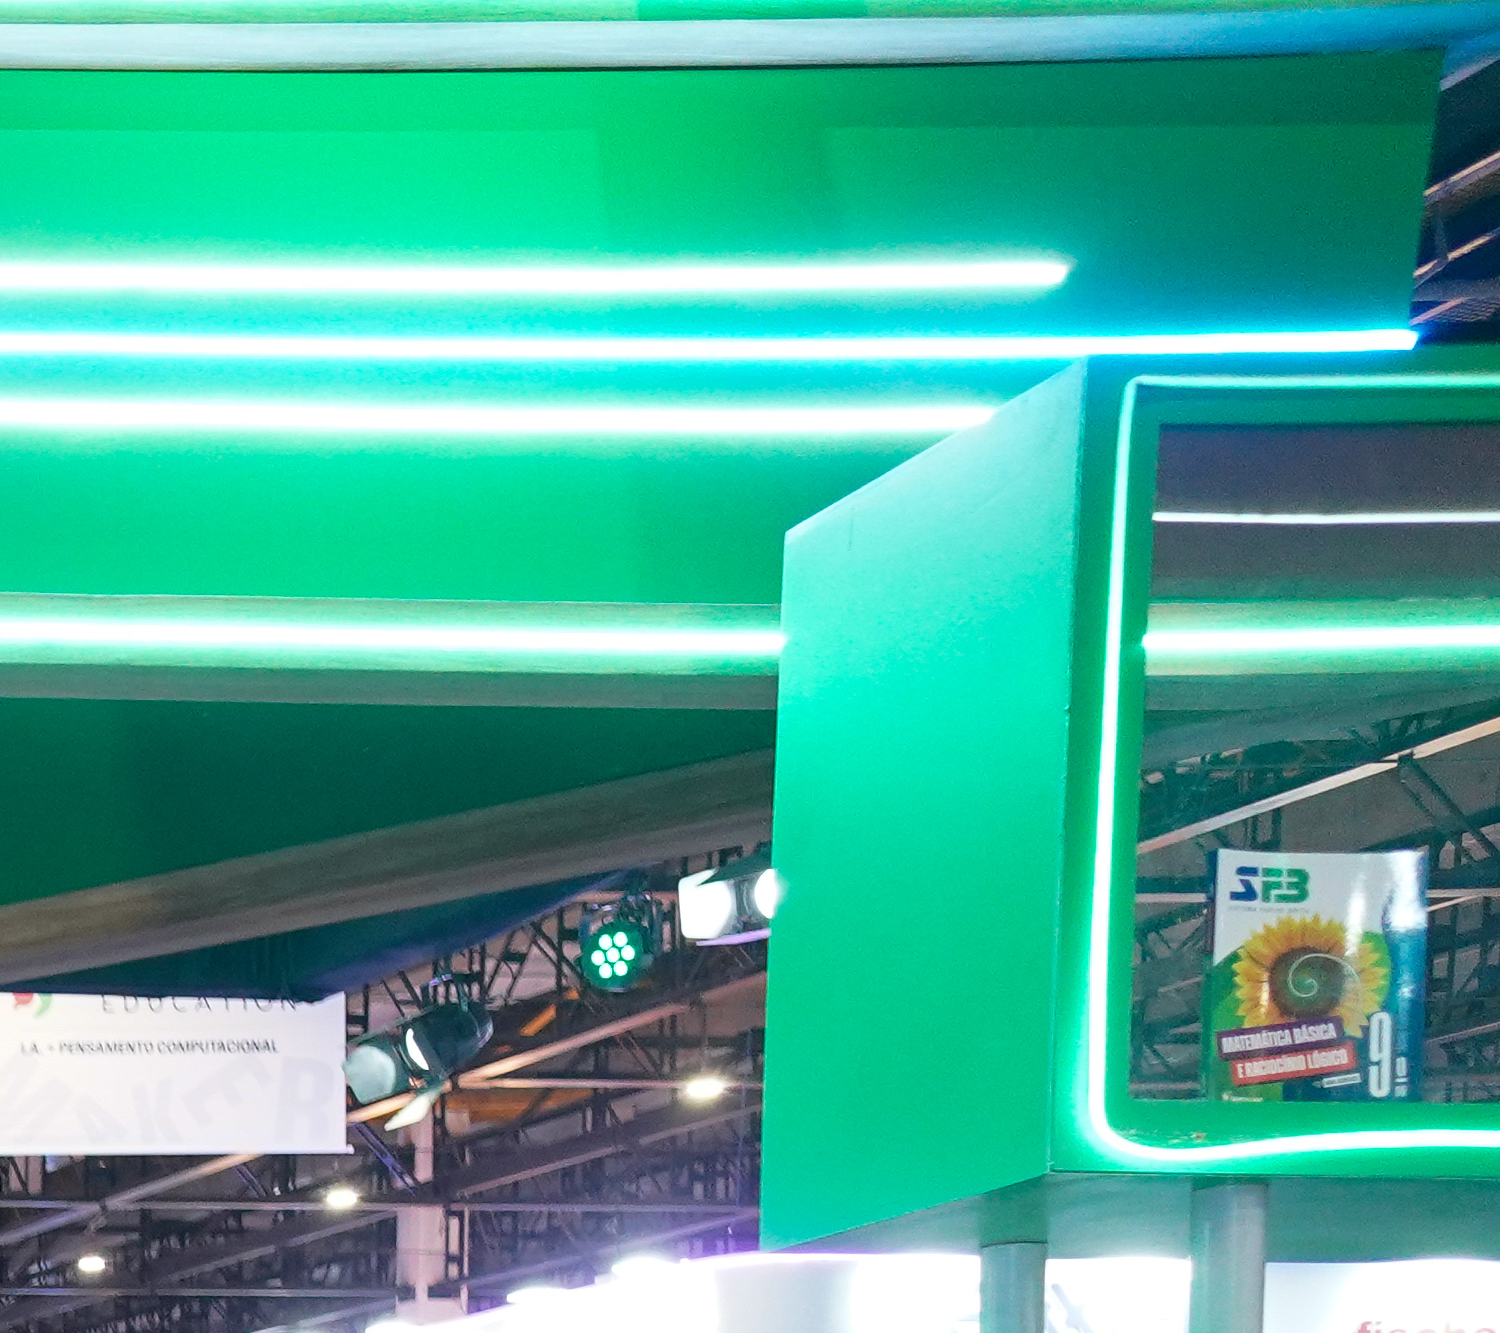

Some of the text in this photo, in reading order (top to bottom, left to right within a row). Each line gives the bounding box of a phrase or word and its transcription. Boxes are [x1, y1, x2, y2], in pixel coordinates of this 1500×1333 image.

[1230, 866, 1310, 903] SFB
[58, 1040, 153, 1055] PENSAMENTO
[157, 1039, 278, 1054] COMPUTACIONAL
